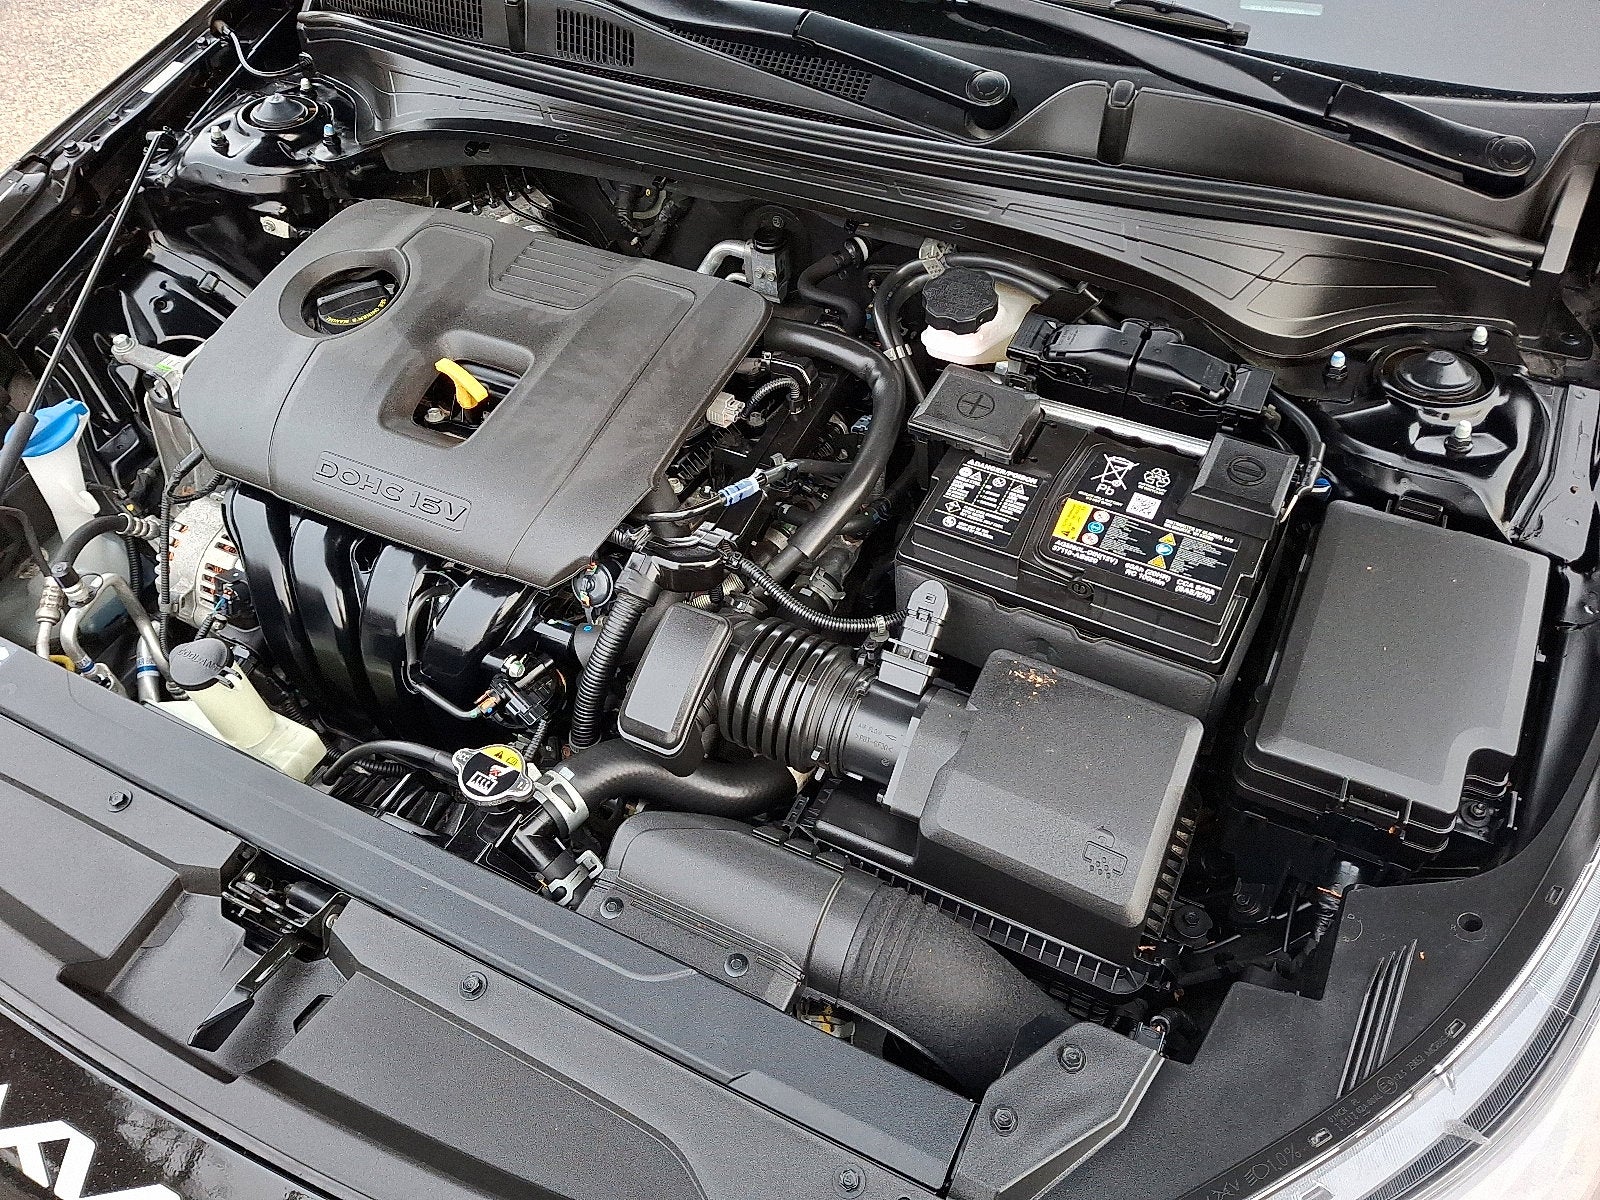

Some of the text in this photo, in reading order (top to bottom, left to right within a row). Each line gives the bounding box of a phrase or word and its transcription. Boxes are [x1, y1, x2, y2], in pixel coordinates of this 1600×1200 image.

[315, 457, 468, 523] DOHC 16V
[1095, 483, 1115, 496] Pb
